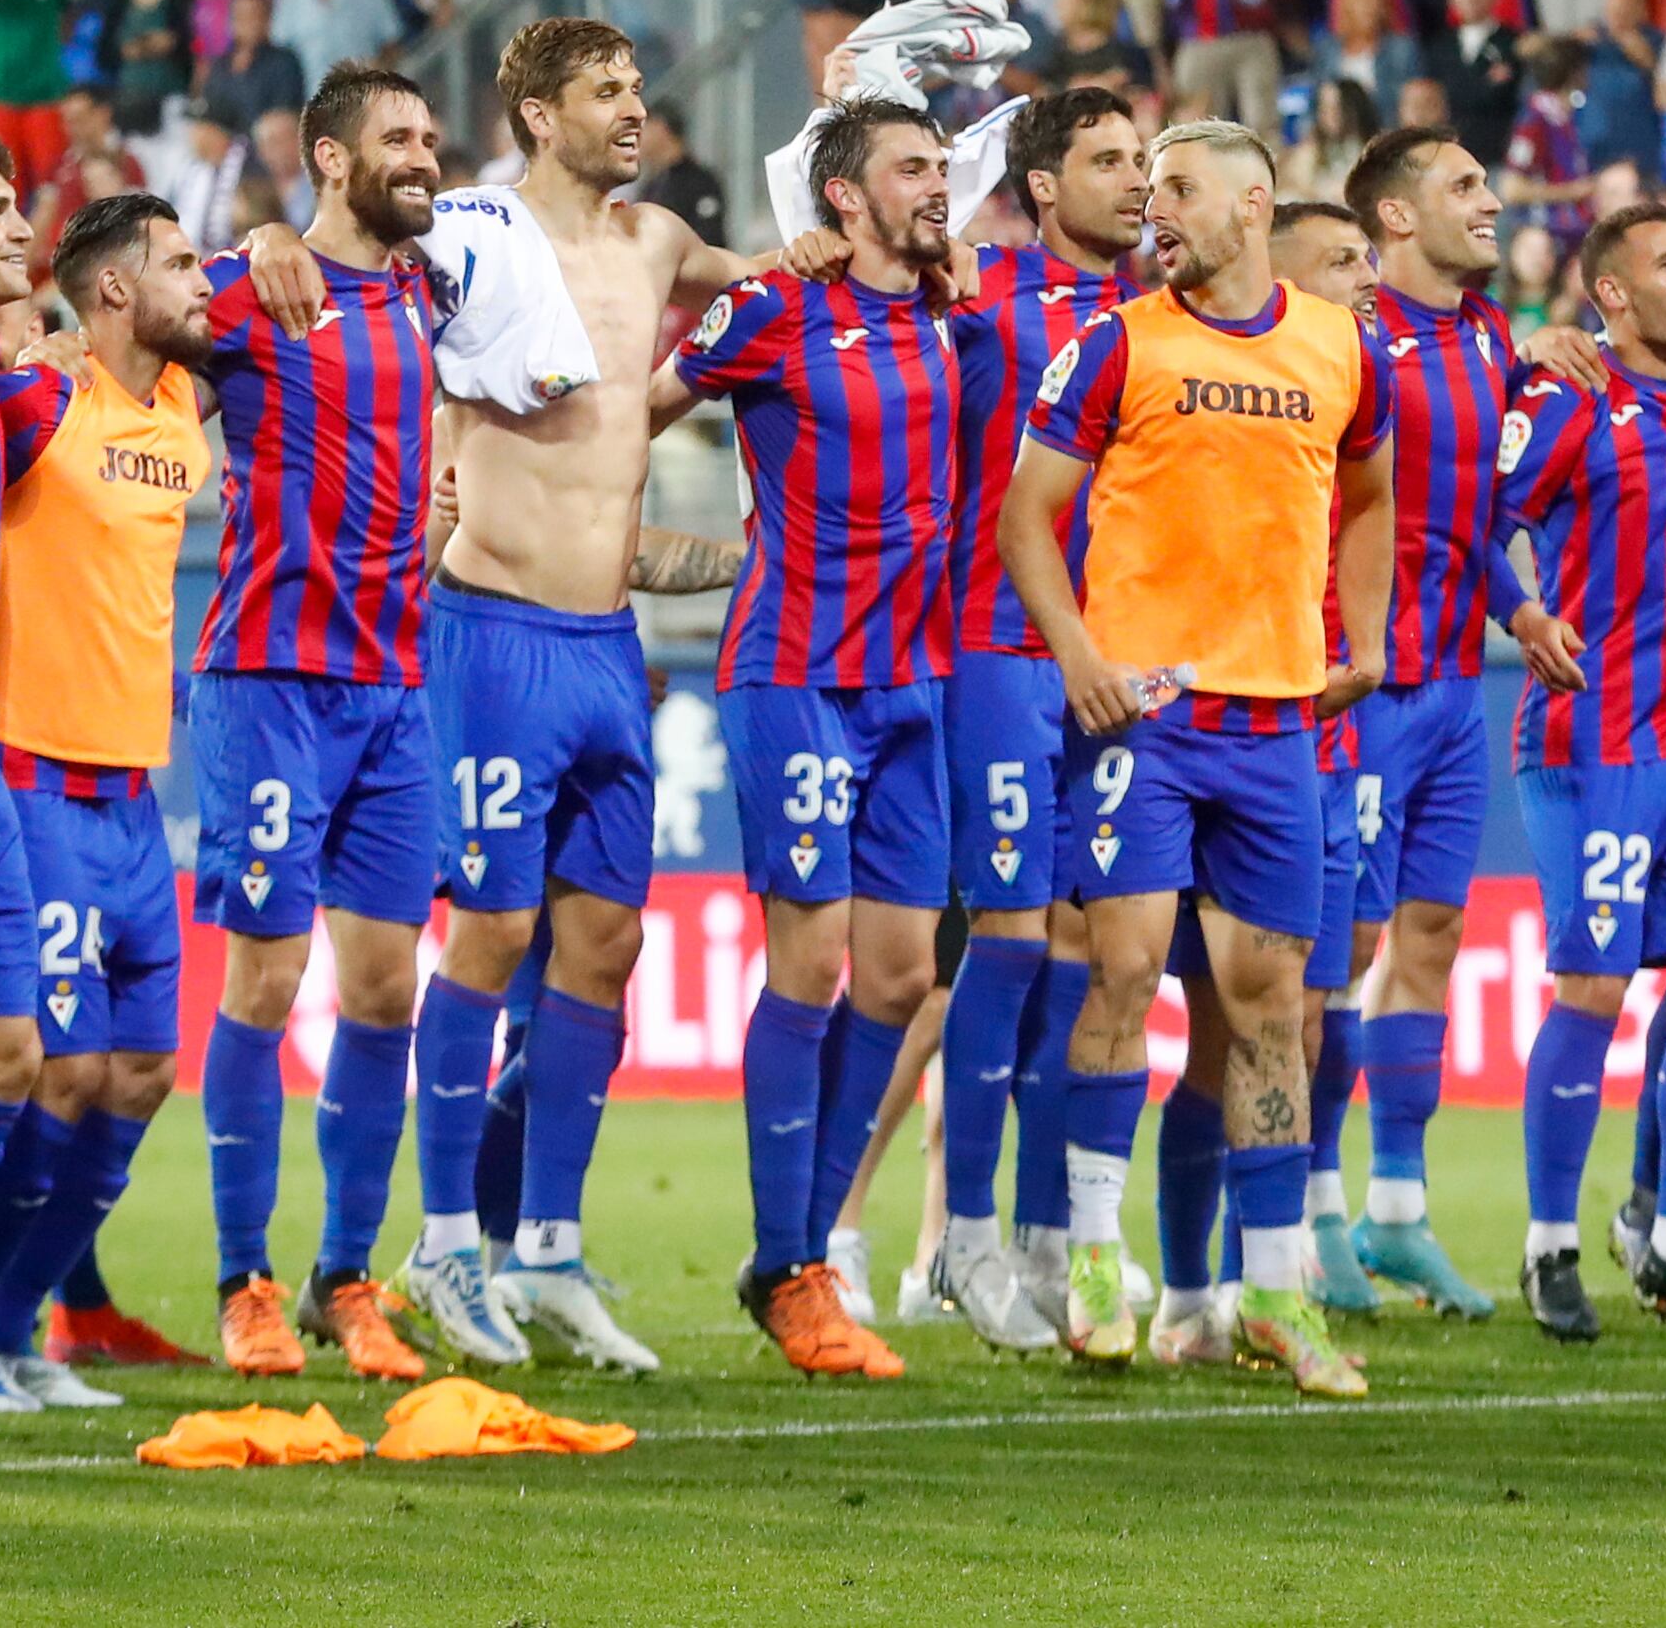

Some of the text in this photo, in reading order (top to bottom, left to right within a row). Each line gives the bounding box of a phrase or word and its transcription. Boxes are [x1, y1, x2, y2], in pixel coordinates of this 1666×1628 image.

[434, 200, 512, 227] tene
[249, 777, 292, 853] 3
[452, 755, 523, 831] 12
[782, 751, 854, 827] 33
[987, 760, 1030, 832] 5
[1092, 745, 1135, 816] 9
[1582, 829, 1653, 904] 22
